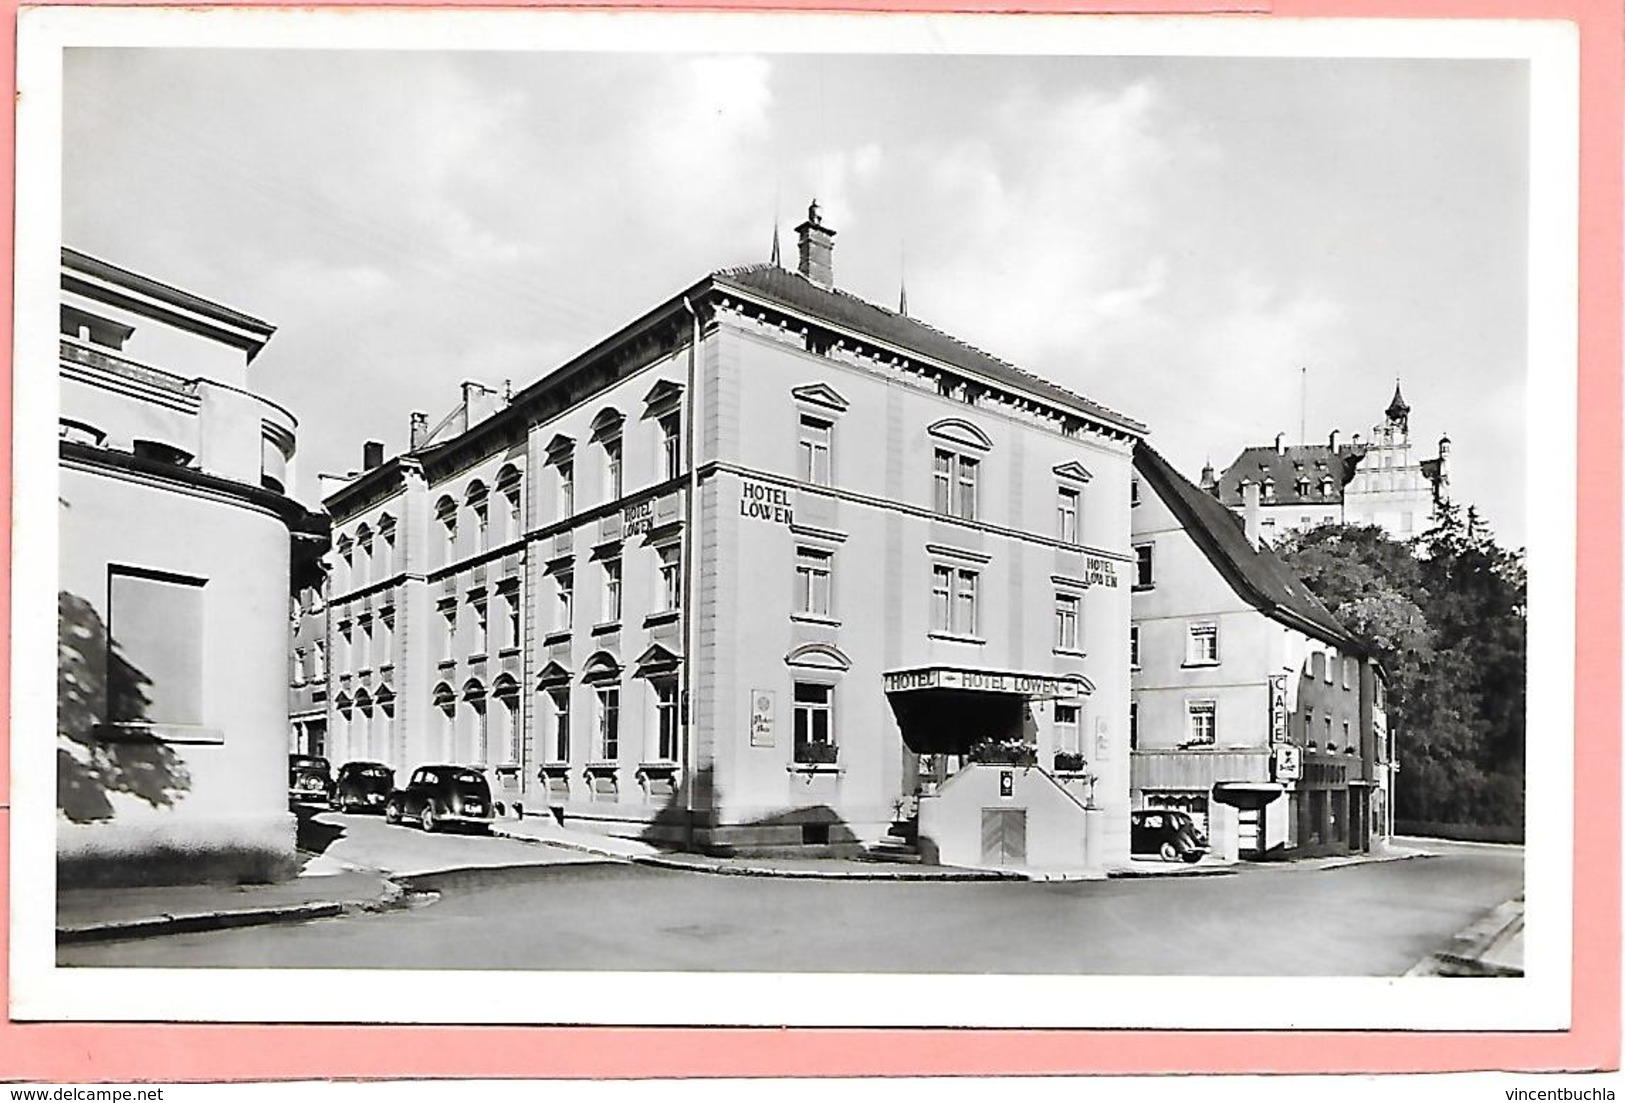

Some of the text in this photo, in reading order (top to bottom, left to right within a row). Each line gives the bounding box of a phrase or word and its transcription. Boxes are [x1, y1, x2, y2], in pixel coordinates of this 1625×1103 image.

[743, 482, 792, 506] HOTEL
[624, 501, 653, 523] HOTEL
[1086, 557, 1116, 574] HOTEL
[891, 671, 935, 690] HOTEL
[961, 673, 1007, 690] HOTEL
